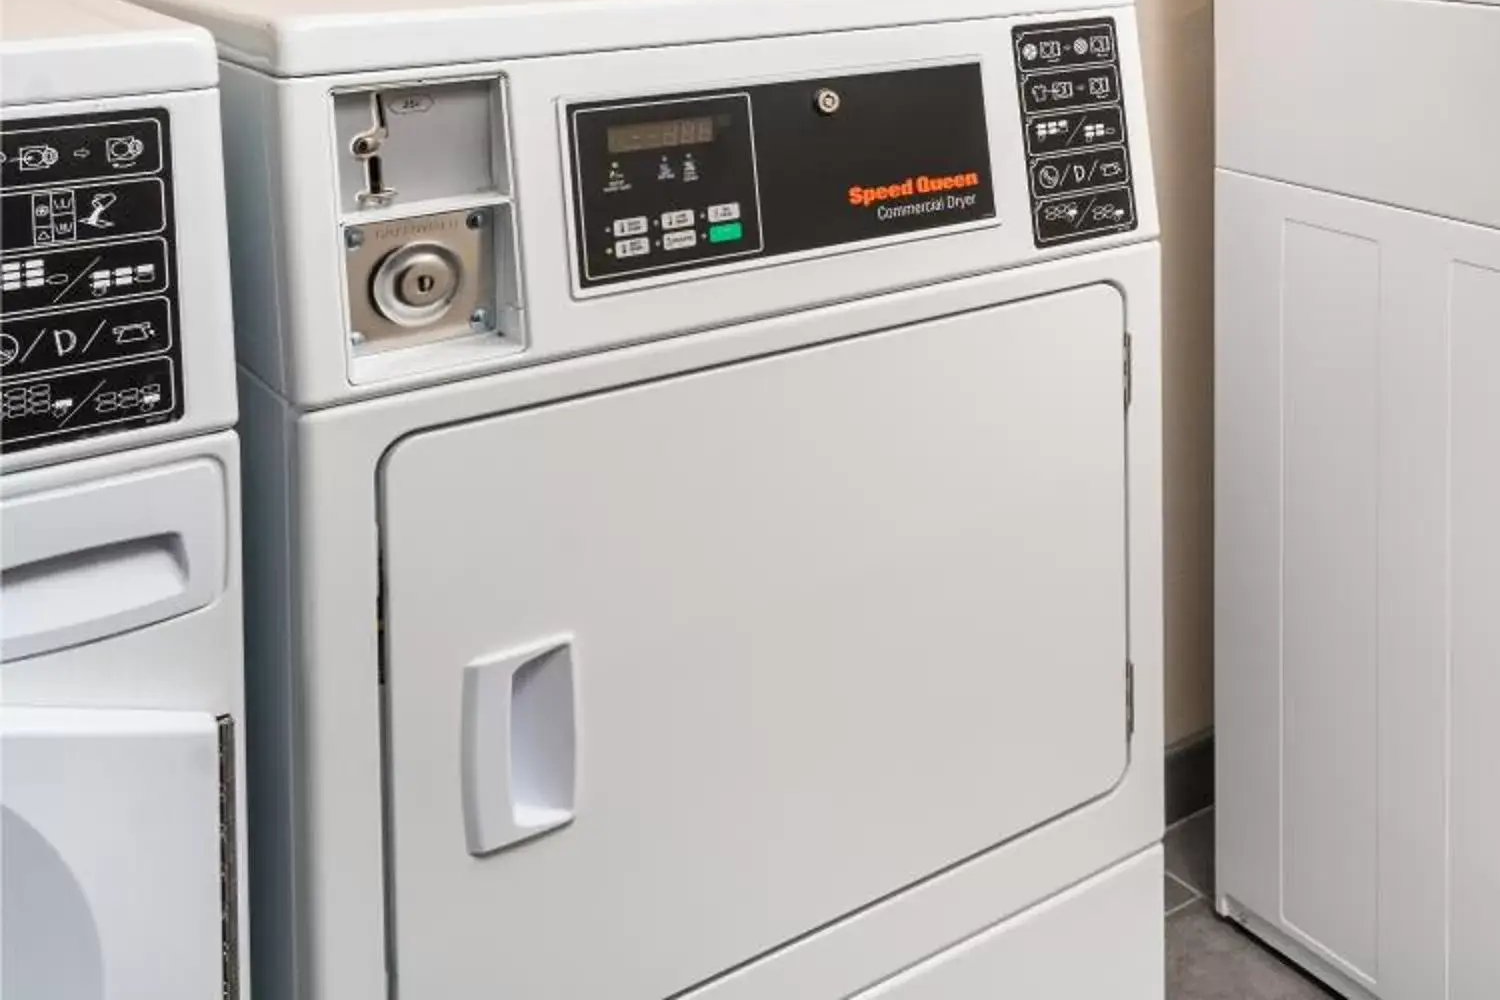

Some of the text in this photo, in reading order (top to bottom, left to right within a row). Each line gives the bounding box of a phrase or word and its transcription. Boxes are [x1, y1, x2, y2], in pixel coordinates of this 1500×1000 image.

[848, 172, 979, 207] Speed Queen
[877, 193, 977, 221] Commercial Dryer
